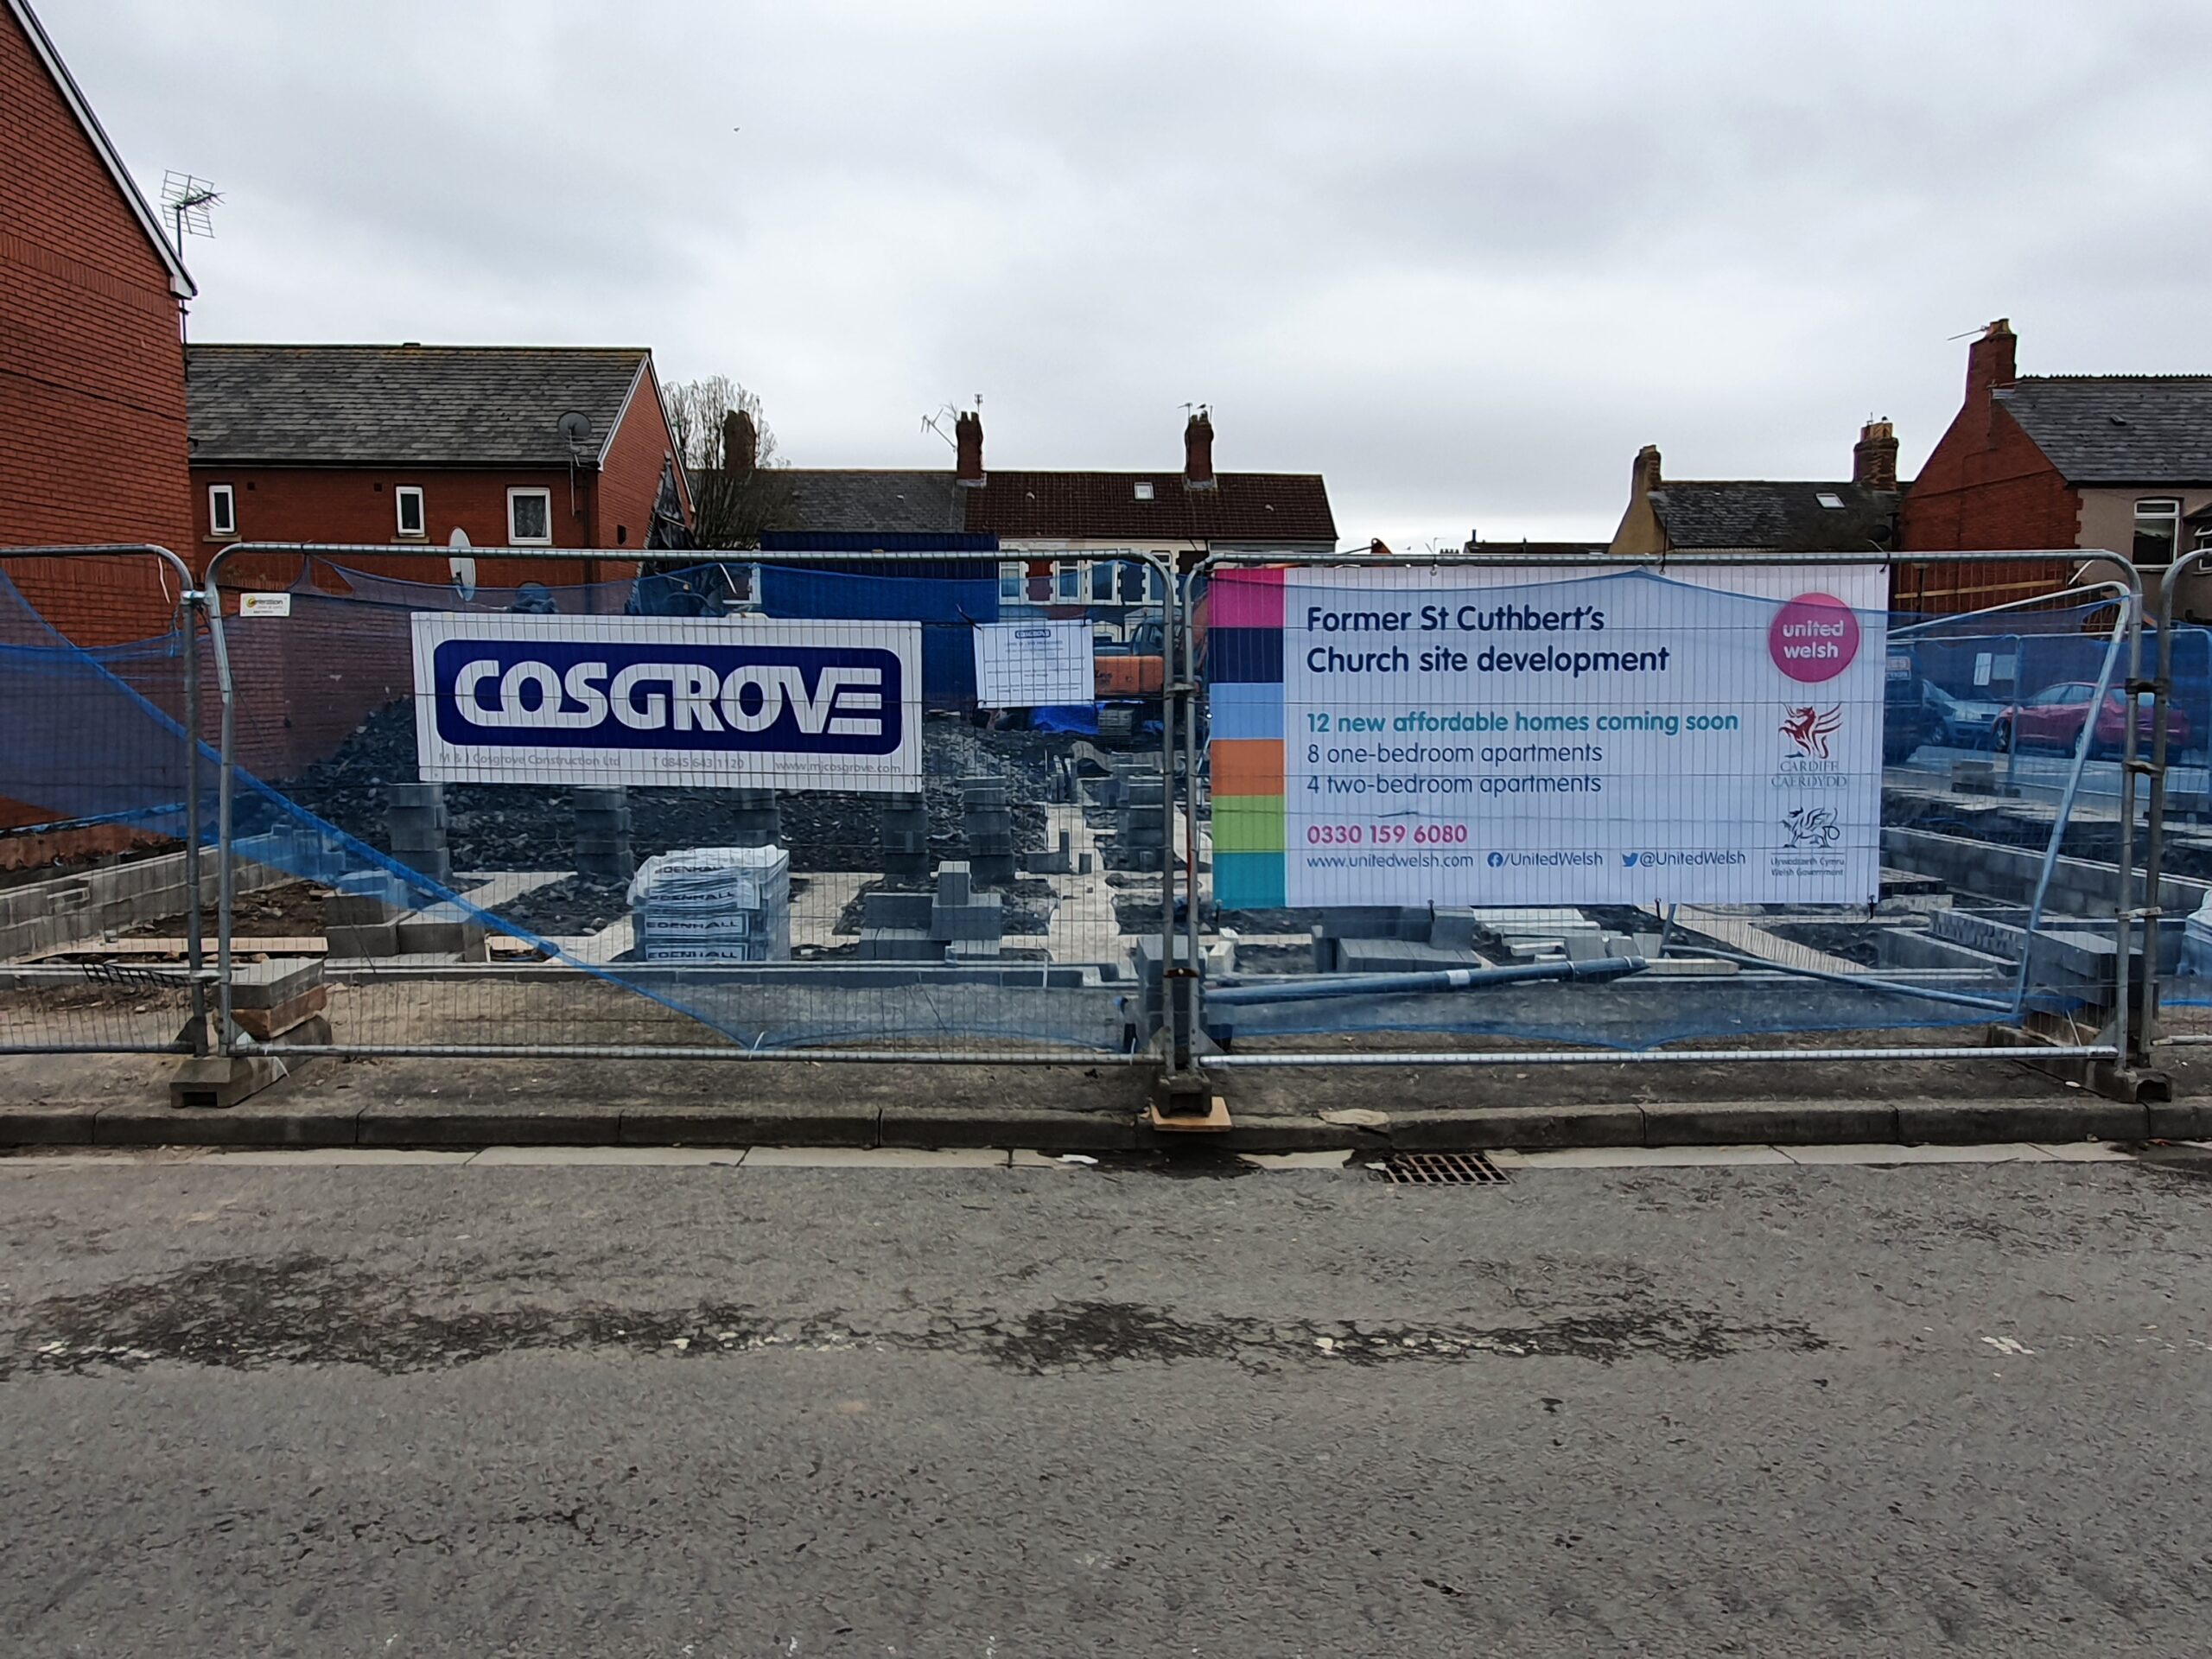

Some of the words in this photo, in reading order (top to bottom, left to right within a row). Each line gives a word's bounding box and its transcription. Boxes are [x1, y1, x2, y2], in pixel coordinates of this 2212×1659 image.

[1306, 607, 1412, 632] Former
[1421, 606, 1449, 632] St
[1457, 604, 1605, 632] Cuthbert's
[1783, 620, 1845, 638] united
[1783, 641, 1840, 658] welsh
[1306, 645, 1409, 673] Church
[1418, 645, 1468, 673] site
[1477, 645, 1670, 678] development
[454, 659, 882, 735] COSGROVE
[1307, 713, 1331, 733] 12
[1338, 716, 1386, 732] new
[1393, 711, 1509, 732] affordable
[1515, 711, 1590, 731] homes
[1596, 710, 1679, 736] coming
[1686, 715, 1738, 730] soon
[473, 753, 525, 766] Cosgrove
[528, 754, 600, 766] Construction
[603, 756, 621, 767] Ltd
[1307, 744, 1320, 763] 8
[1326, 742, 1474, 763] one-bedroom
[1481, 743, 1603, 767] apartments
[1780, 760, 1839, 772] CARDIFF
[1306, 775, 1320, 794] 4
[1326, 774, 1473, 794] two-bedroom
[1479, 774, 1602, 798] apartments
[1306, 824, 1363, 844] 0330
[1370, 824, 1407, 843] 159
[1413, 824, 1468, 843] 6080
[1306, 852, 1474, 868] www.unitedwelsh.com
[1640, 850, 1747, 868] @UnitedWelsh
